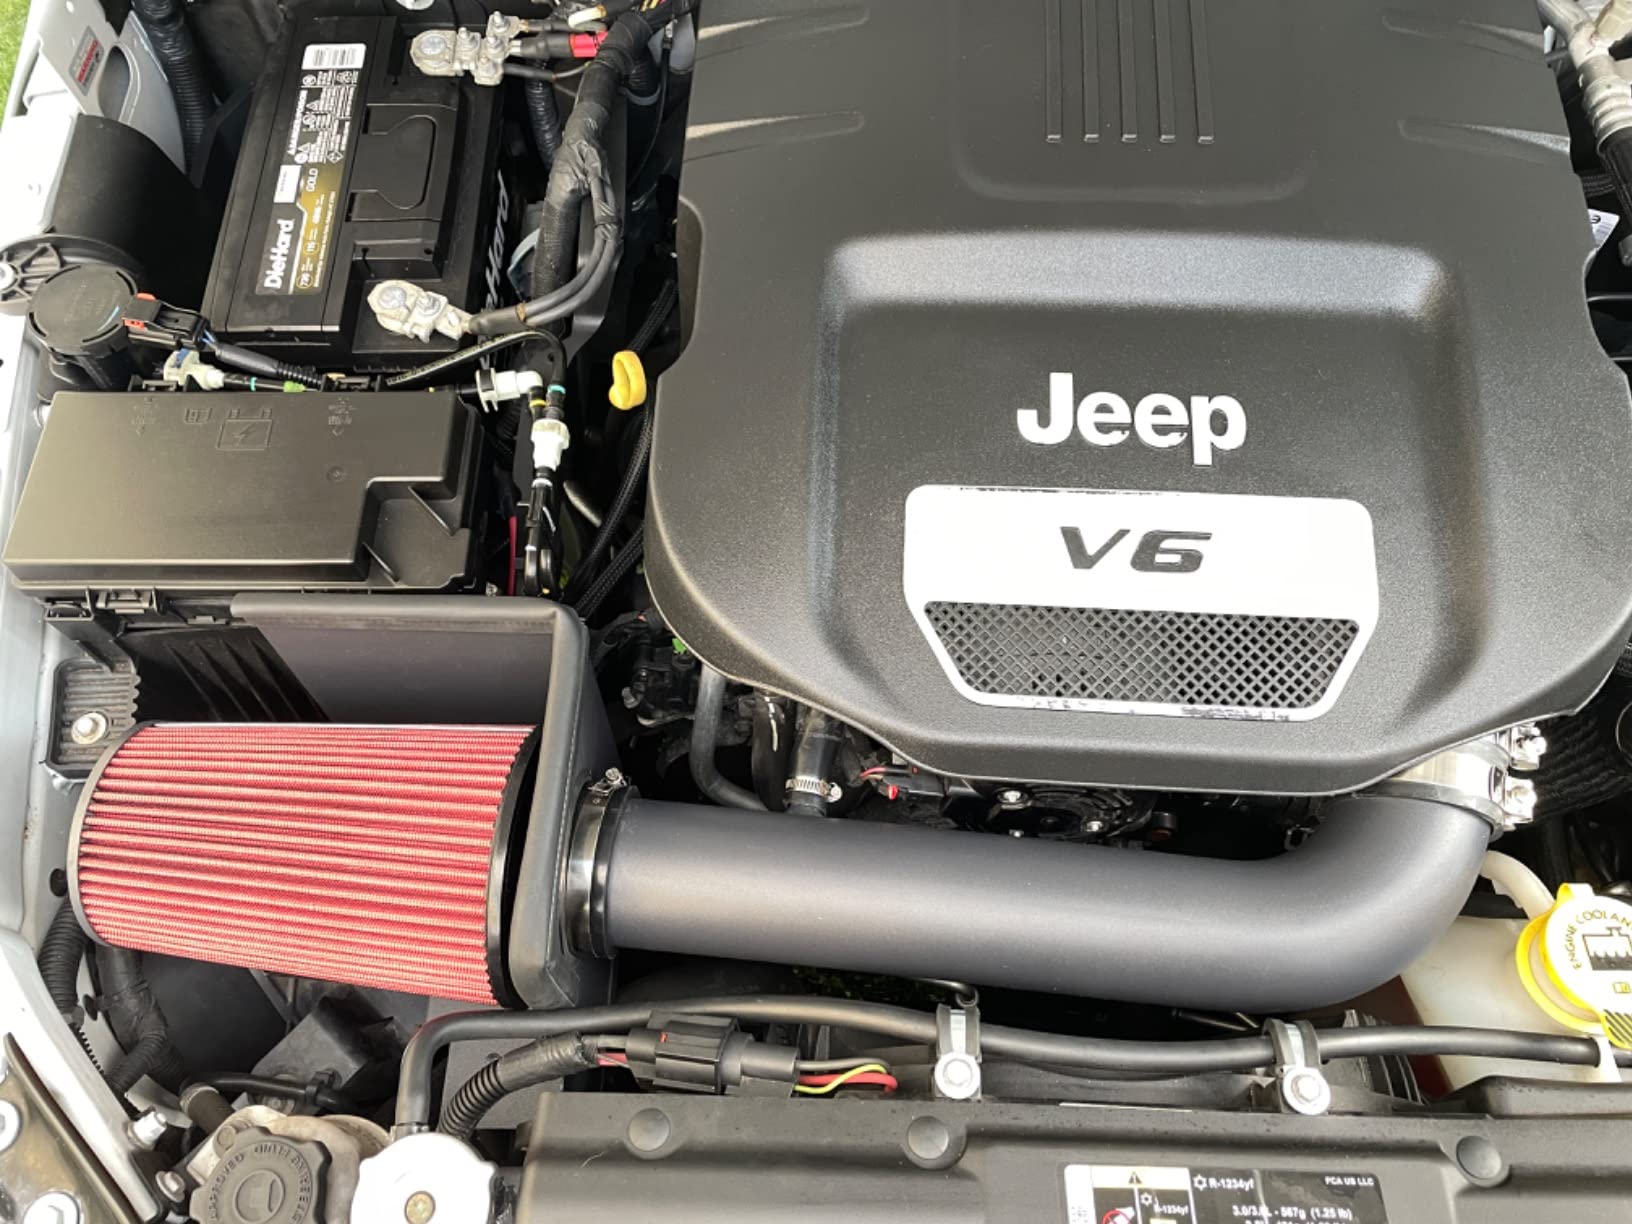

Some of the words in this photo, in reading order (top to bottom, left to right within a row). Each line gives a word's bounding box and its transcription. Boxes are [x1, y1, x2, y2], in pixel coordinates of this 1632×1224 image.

[306, 167, 319, 192] GOLD
[263, 219, 296, 289] DieHard
[1016, 371, 1248, 466] Jeep
[1059, 526, 1213, 573] V6
[1564, 923, 1582, 970] ENGINE
[1575, 908, 1632, 932] COOLAN
[1208, 1177, 1255, 1192] R-1234yf
[1324, 1176, 1343, 1186] FCA
[1344, 1178, 1357, 1186] US
[1358, 1178, 1375, 1186] LLC
[1280, 1206, 1307, 1221] 567g
[1337, 1207, 1353, 1221] lb)
